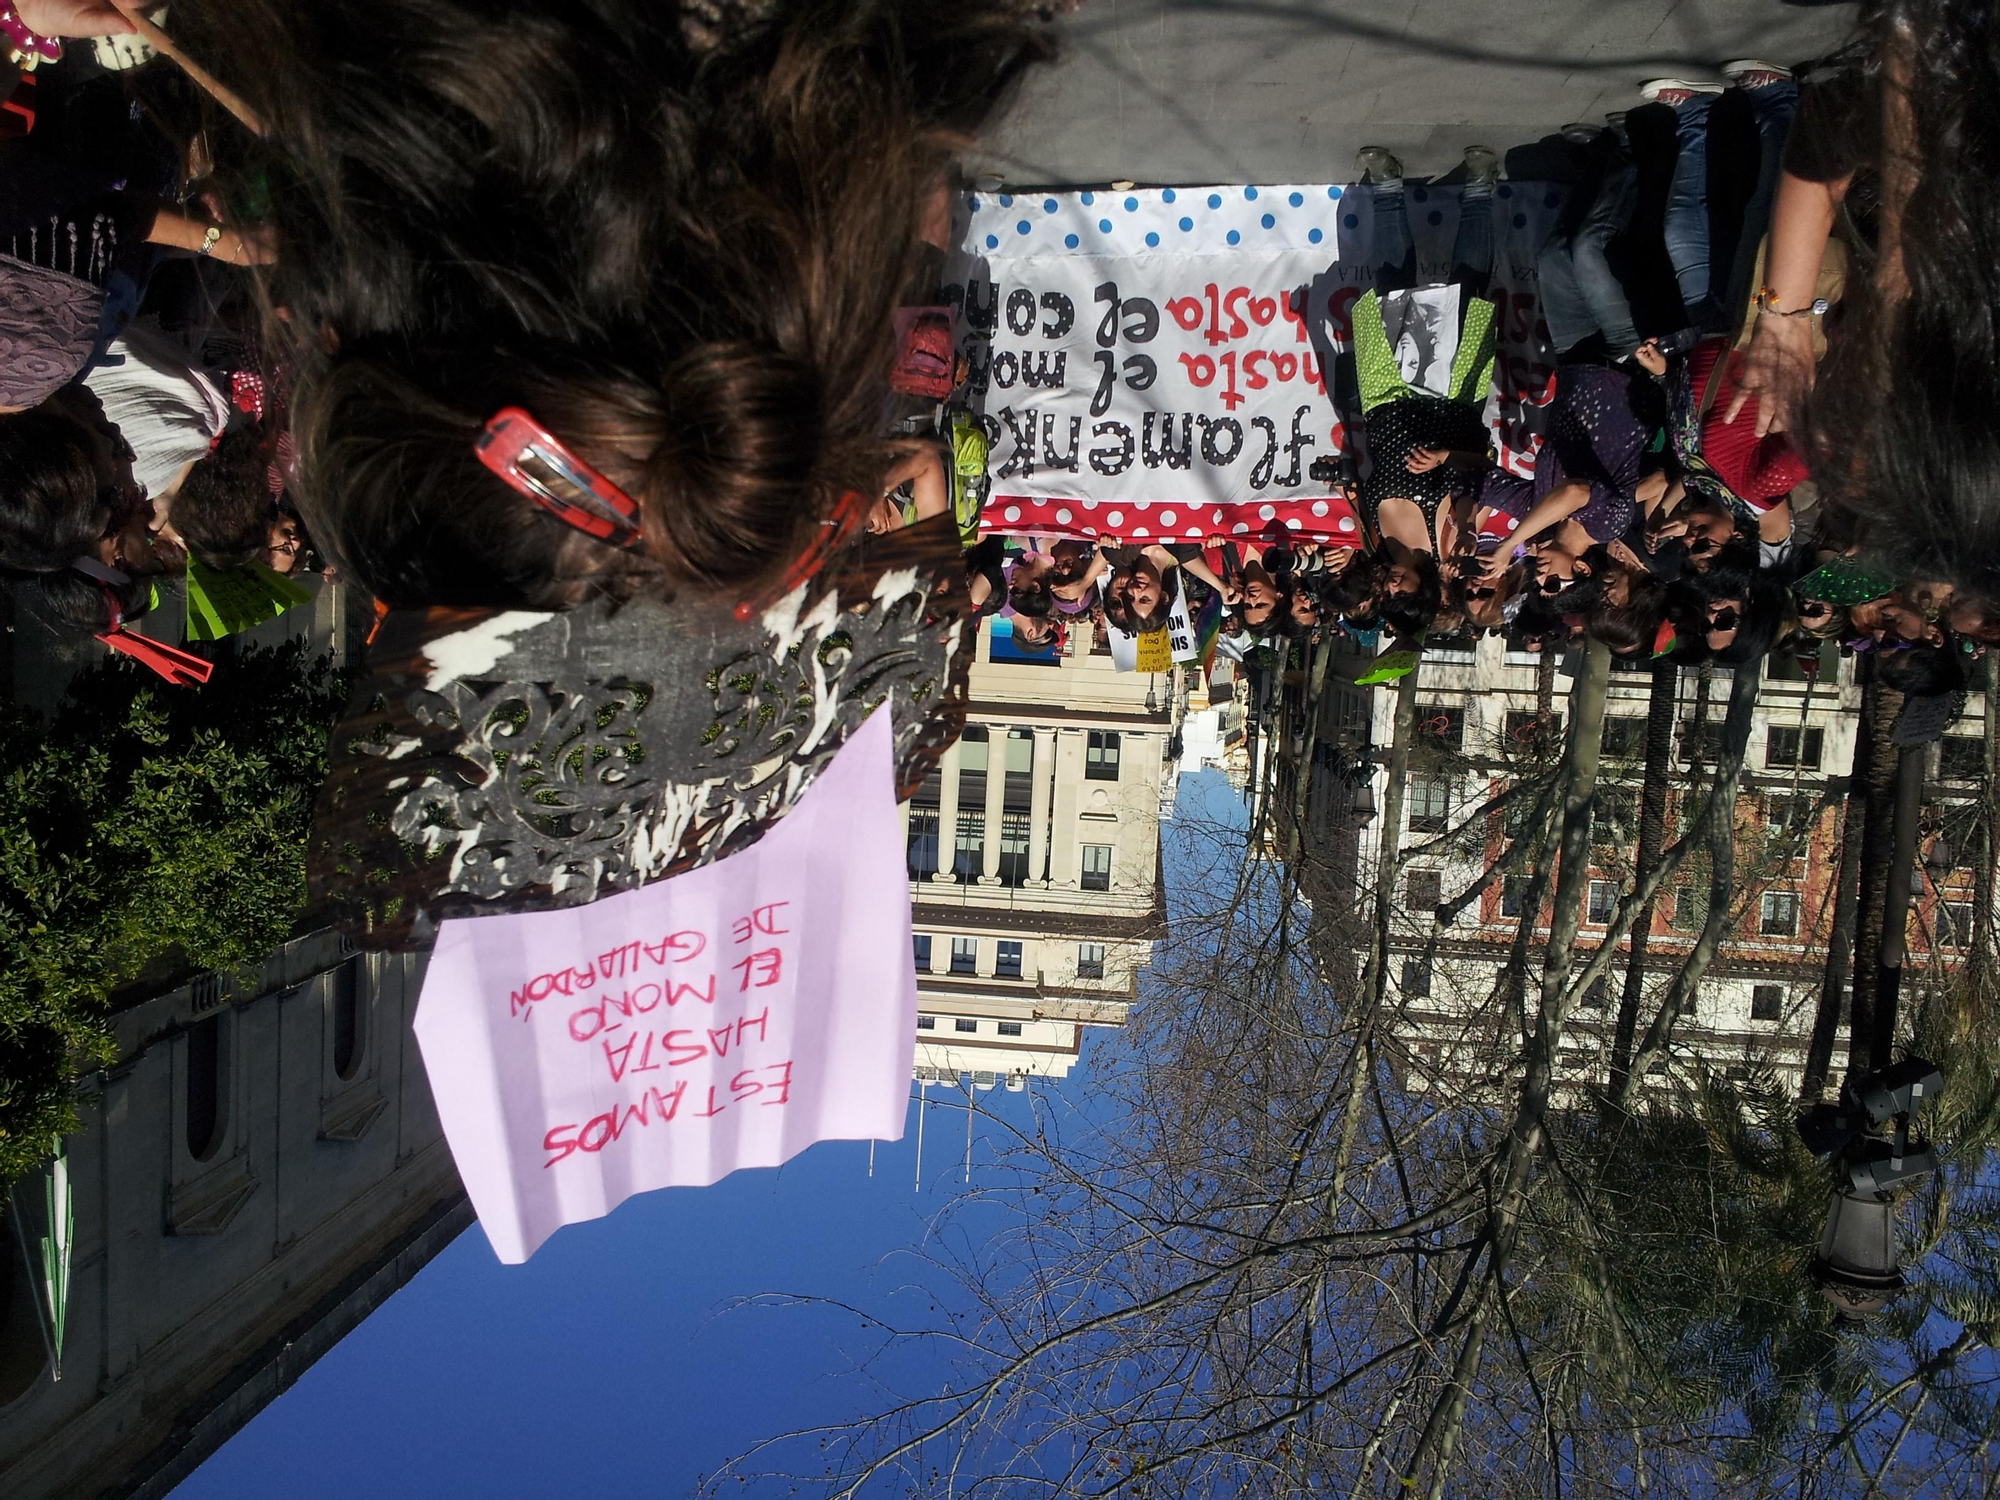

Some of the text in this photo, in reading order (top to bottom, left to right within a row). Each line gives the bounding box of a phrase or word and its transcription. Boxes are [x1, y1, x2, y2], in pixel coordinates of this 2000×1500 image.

[1094, 280, 1160, 348] el
[1166, 283, 1308, 345] hasta
[964, 346, 1326, 417] hasta el moñ
[510, 901, 789, 1022] DE GALLARDÓN
[568, 947, 783, 1042] EL MOÑO
[602, 1009, 769, 1083] HASTA
[543, 1061, 793, 1168] ESTAMOS
